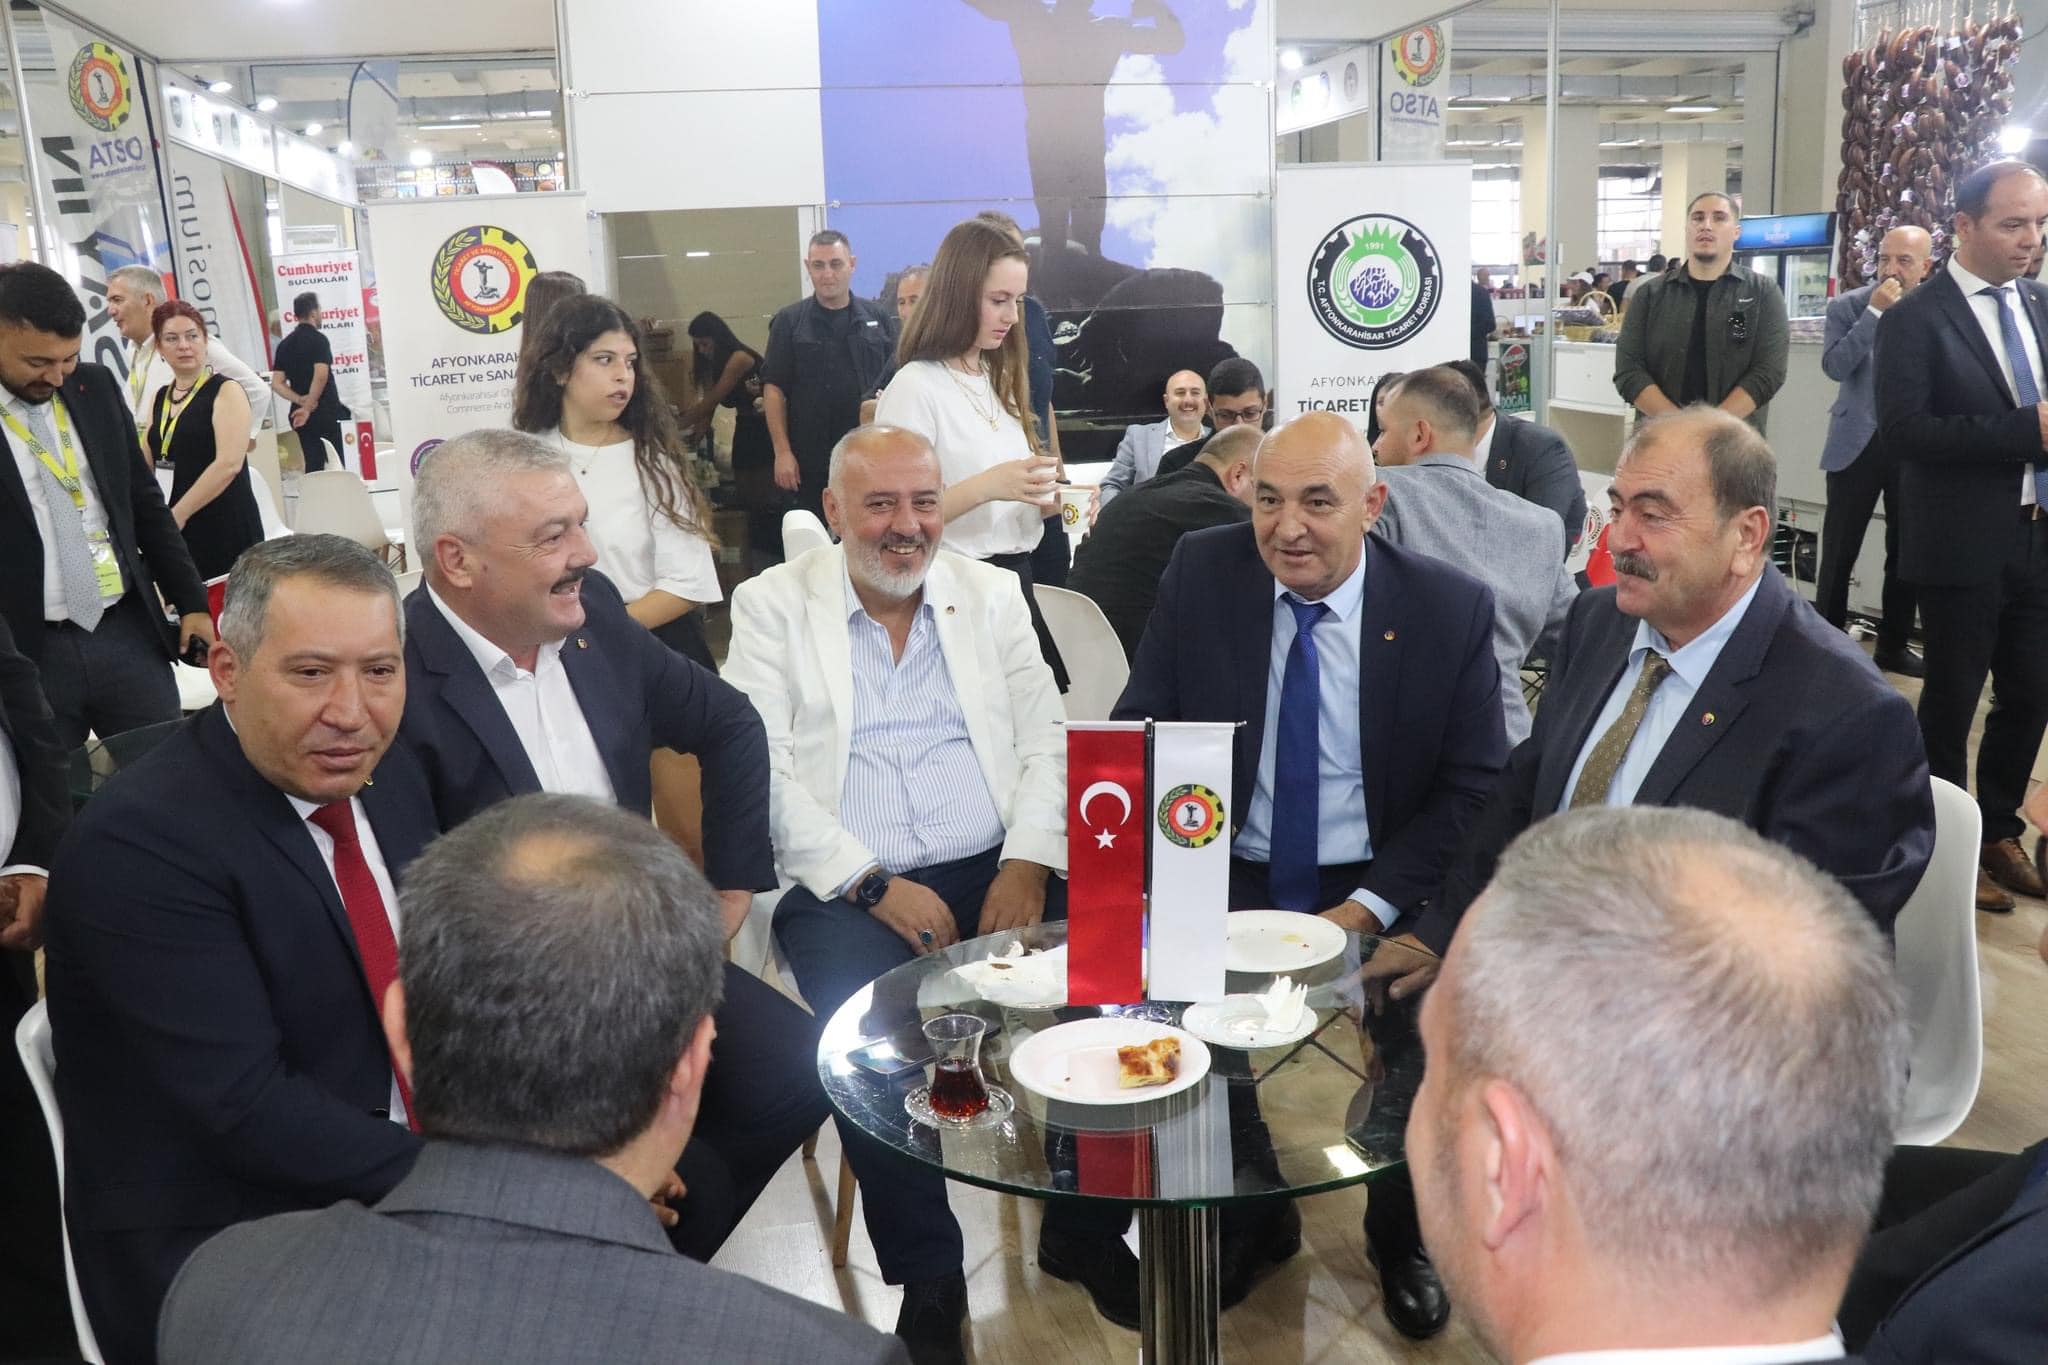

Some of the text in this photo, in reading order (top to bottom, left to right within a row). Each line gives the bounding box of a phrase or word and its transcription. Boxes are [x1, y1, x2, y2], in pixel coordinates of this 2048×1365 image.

[90, 136, 143, 169] ATSO
[278, 261, 352, 276] Cumhuriyet
[288, 275, 348, 287] SUCUKLARI
[1320, 297, 1385, 340] AFYONKARAHİSAR
[1386, 314, 1418, 338] TİCARET
[1415, 276, 1433, 316] BORSASI
[410, 368, 517, 387] TİCARET ve SAN
[1297, 396, 1369, 413] TİCARET
